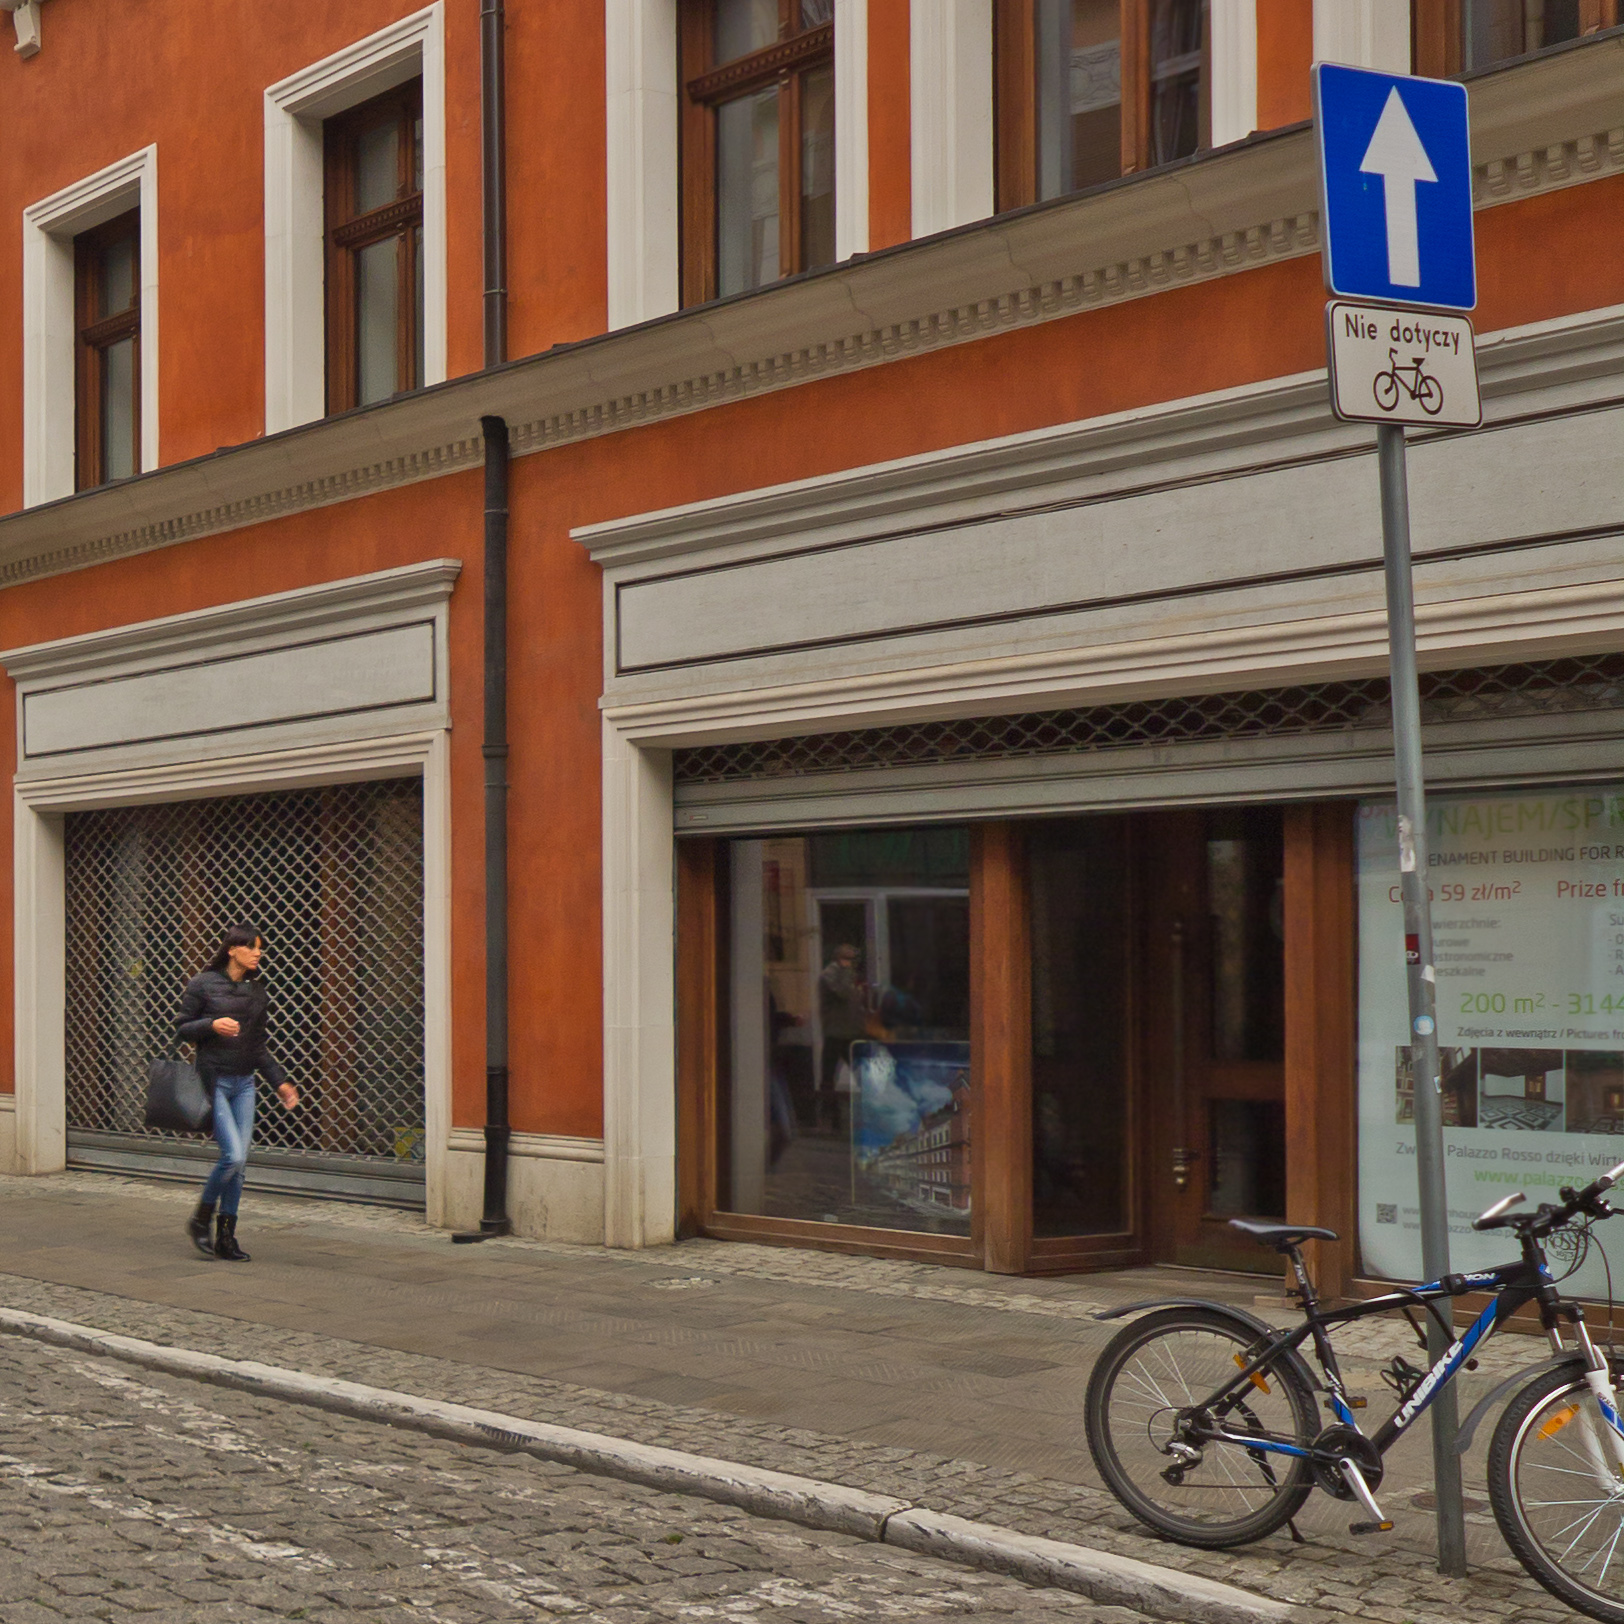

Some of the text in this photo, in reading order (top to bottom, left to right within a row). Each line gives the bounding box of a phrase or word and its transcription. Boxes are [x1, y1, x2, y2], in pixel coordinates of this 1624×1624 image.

[1345, 313, 1460, 356] Nie dotyczy
[1384, 793, 1624, 840] WNAJEM/SPR
[1429, 851, 1497, 867] ENAMENT
[1503, 847, 1575, 864] BUILDING
[1579, 845, 1611, 860] FOR
[1388, 885, 1434, 903] Ca
[1440, 884, 1466, 902] 59
[1557, 880, 1606, 898] Prize
[1432, 916, 1502, 930] wierzchnie:
[1460, 992, 1506, 1013] 200
[1457, 1026, 1494, 1039] Zdjęcia
[1506, 1028, 1557, 1040] wewnątrz
[1566, 1028, 1609, 1040] Pictures
[1447, 1144, 1498, 1160] Palazzo
[1502, 1147, 1543, 1163] Rosso
[1546, 1149, 1585, 1166] dzięki
[1393, 1339, 1464, 1429] UNIBIKE
